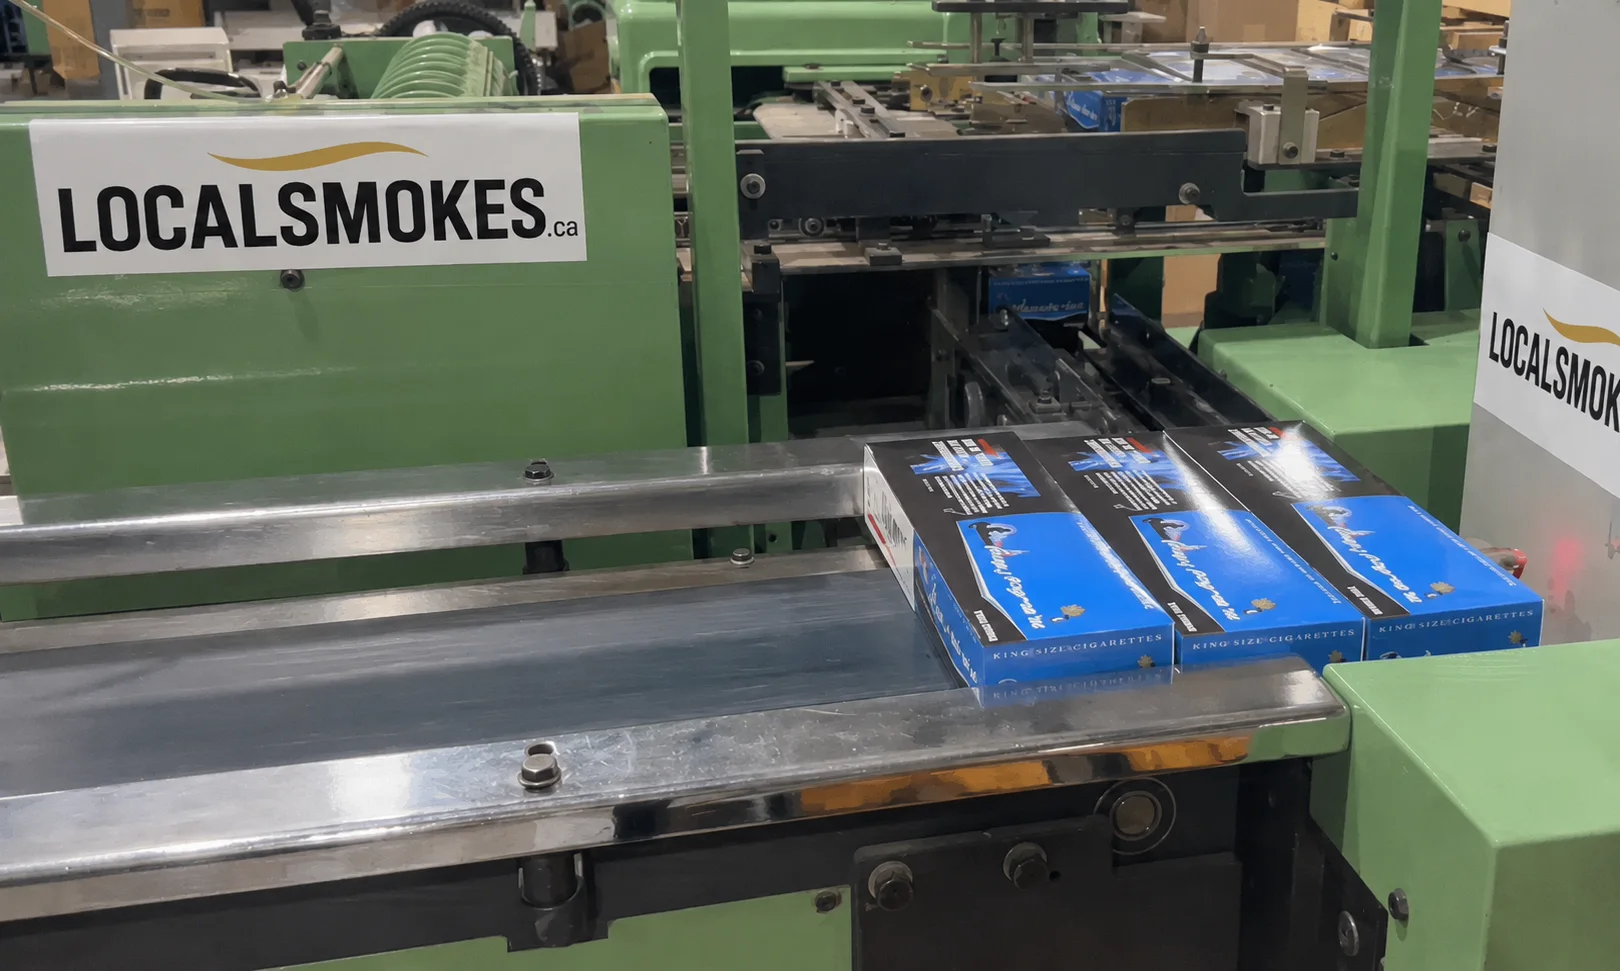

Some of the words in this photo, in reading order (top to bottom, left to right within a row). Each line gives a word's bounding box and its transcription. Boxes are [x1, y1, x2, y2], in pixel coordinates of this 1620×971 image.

[1378, 623, 1414, 633] KING
[1418, 619, 1448, 629] SIZE
[1452, 609, 1534, 624] CIGARETTES
[993, 650, 1029, 660] KING
[1035, 645, 1067, 655] SIZE
[1072, 633, 1162, 650] CIGARETTES
[1192, 641, 1229, 650] KING
[1233, 638, 1264, 646] SIZE
[1269, 629, 1355, 643] CIGARETTES
